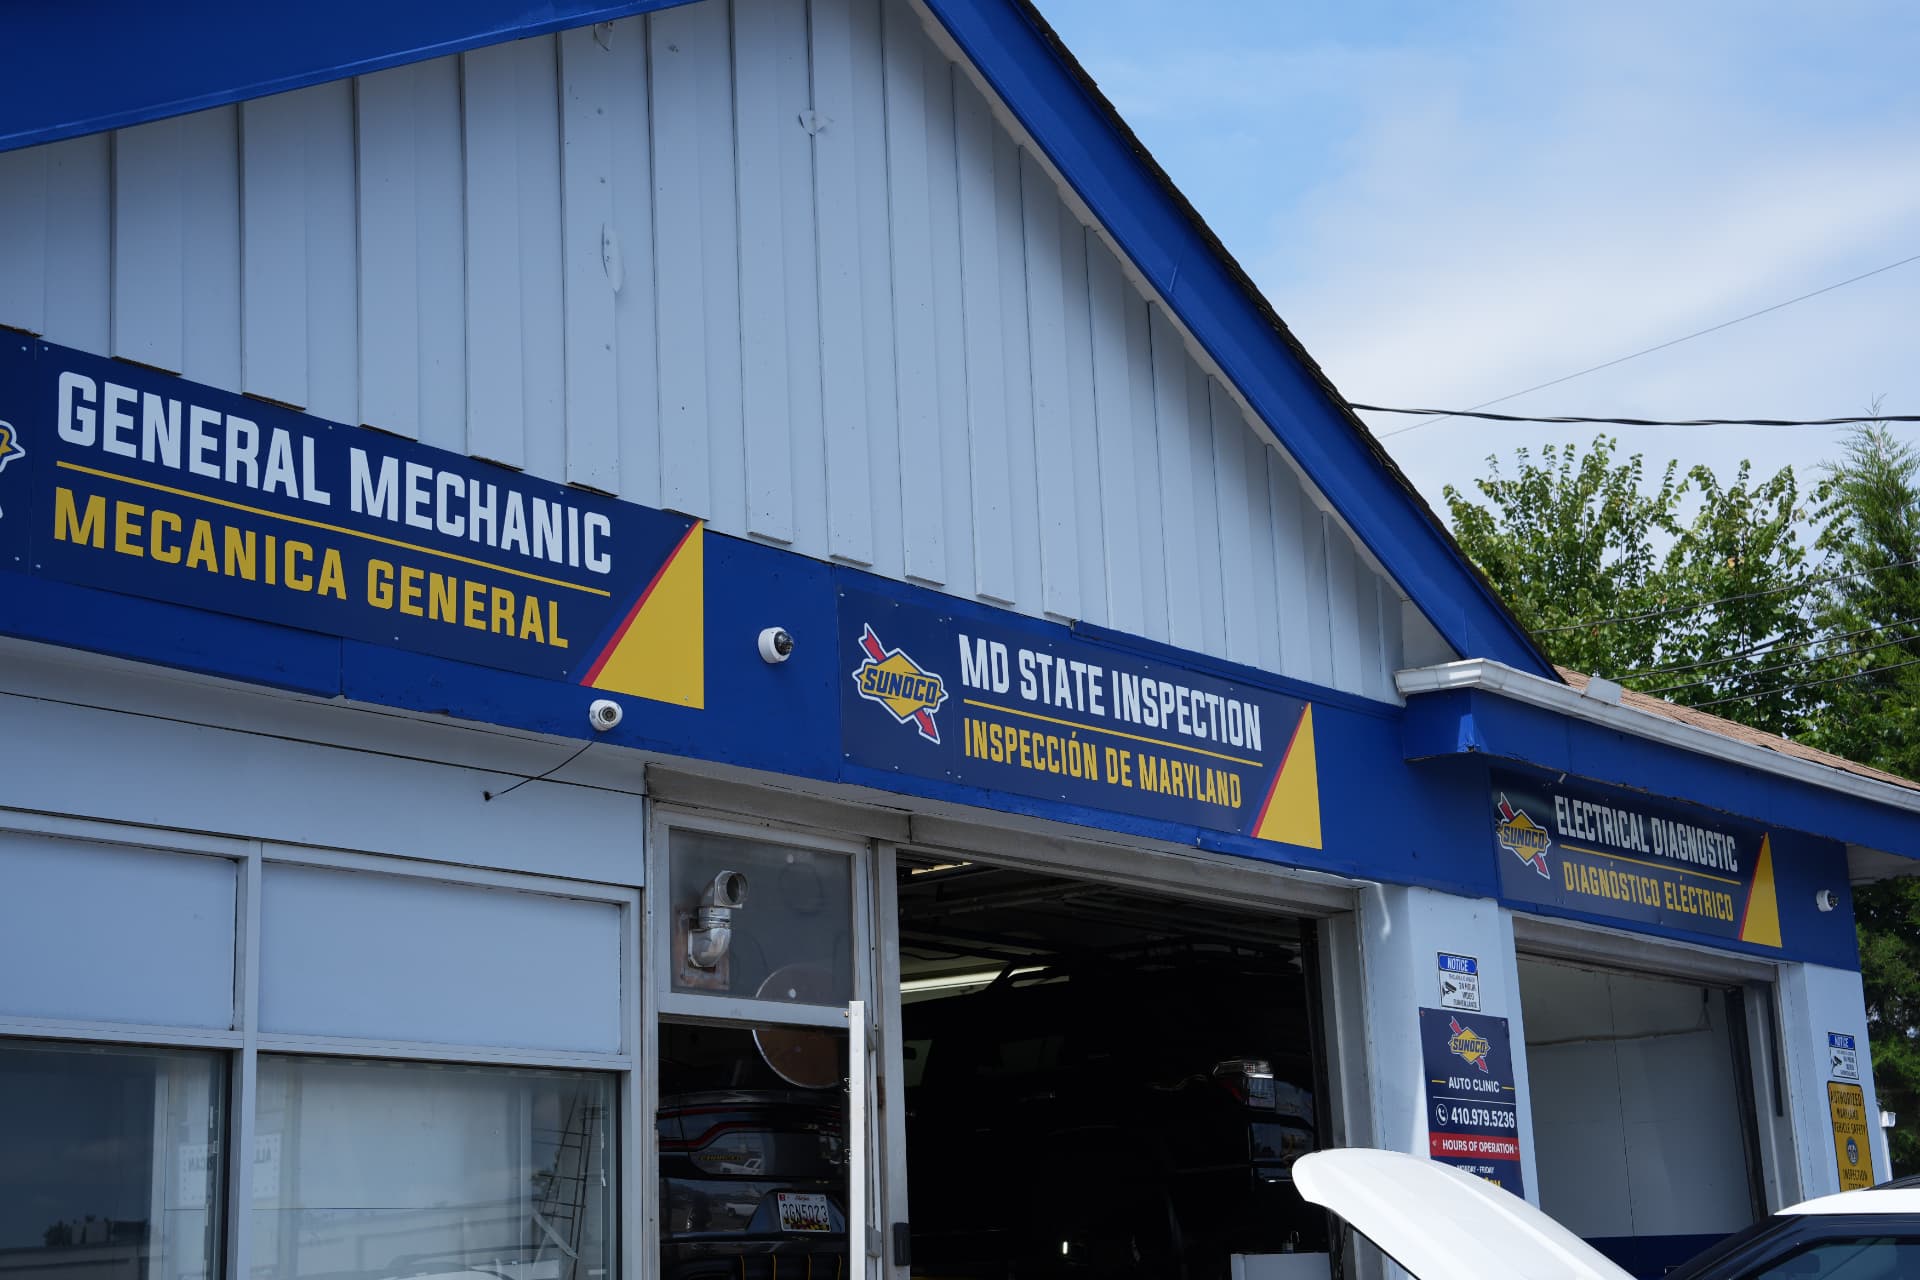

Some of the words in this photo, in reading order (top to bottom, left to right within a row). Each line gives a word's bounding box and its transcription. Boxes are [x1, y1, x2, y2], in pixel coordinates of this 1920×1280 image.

[58, 371, 331, 506] GENERAL
[350, 448, 612, 575] MECHANIC
[53, 487, 347, 600] MECANICA
[367, 558, 569, 649] GENERAL
[863, 668, 938, 705] SUNOCO
[958, 633, 1010, 695] MD
[1018, 648, 1105, 716] STATE
[1112, 670, 1262, 752] INSPECTION
[964, 717, 1099, 781] INSPECCIÓN
[1105, 746, 1133, 786] DE
[1138, 753, 1242, 809] MARYLAND
[1502, 826, 1547, 850] SUNOCO
[1554, 795, 1650, 853] ELECTRICAL
[1651, 816, 1739, 873] DIAGNOSTIC
[1563, 861, 1661, 908] DIAGNÓSTICO
[1664, 875, 1734, 922] ELÉCTRICO
[1447, 957, 1469, 971] NOTICE
[1452, 1036, 1486, 1054] SUNOCO
[1448, 1076, 1471, 1090] AUTO
[1473, 1079, 1500, 1093] CLINIC
[1451, 1106, 1515, 1129] 410.979.5236
[1442, 1139, 1468, 1152] HOURS
[1469, 1141, 1478, 1153] OF
[1479, 1141, 1514, 1154] OPERATION
